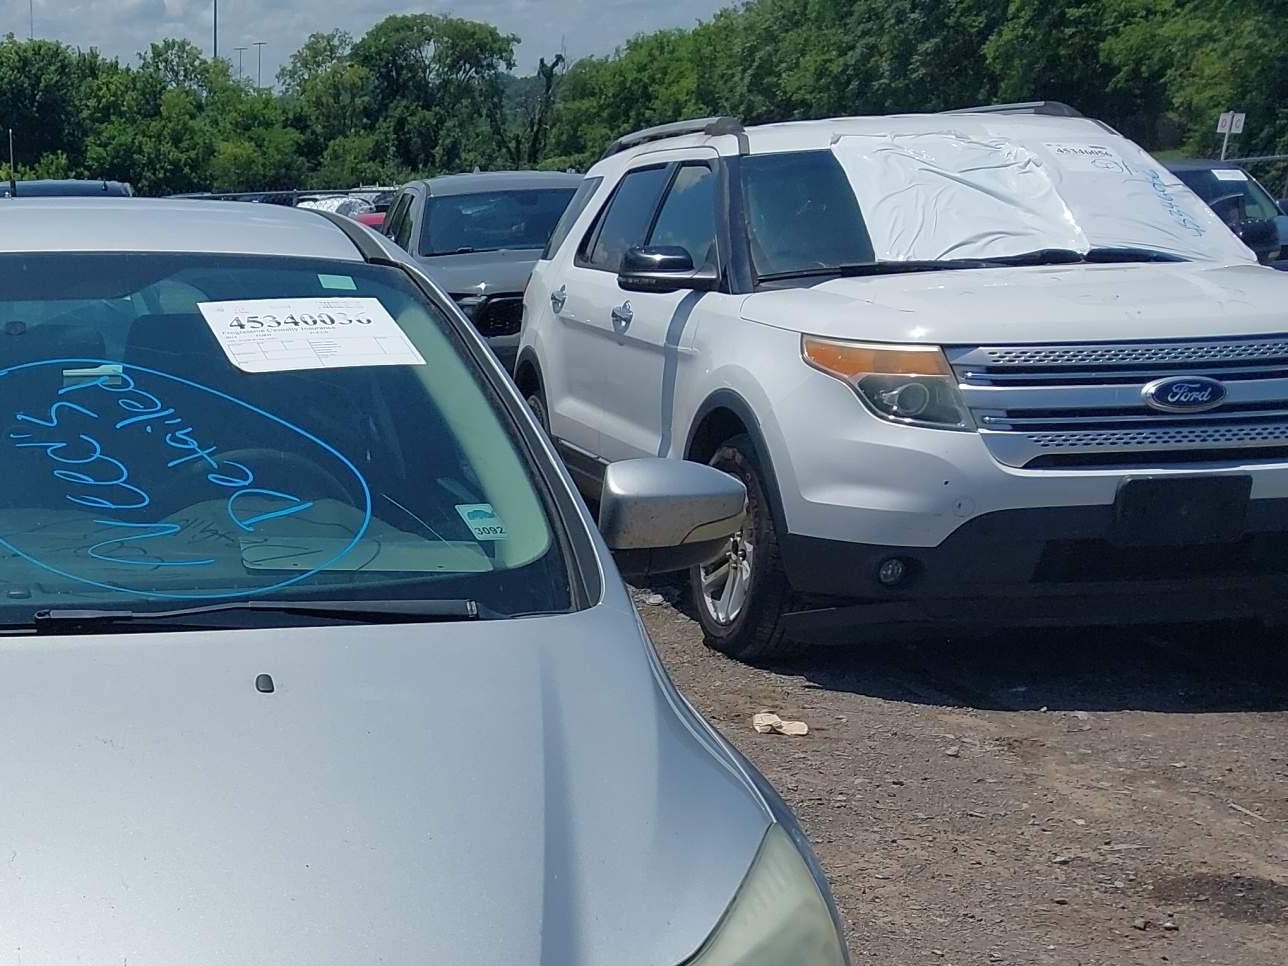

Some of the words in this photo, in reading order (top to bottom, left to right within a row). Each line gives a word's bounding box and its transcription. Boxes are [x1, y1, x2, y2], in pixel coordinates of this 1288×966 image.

[229, 312, 372, 330] 45340036
[1168, 383, 1211, 402] Ford
[474, 526, 505, 535] 3092
